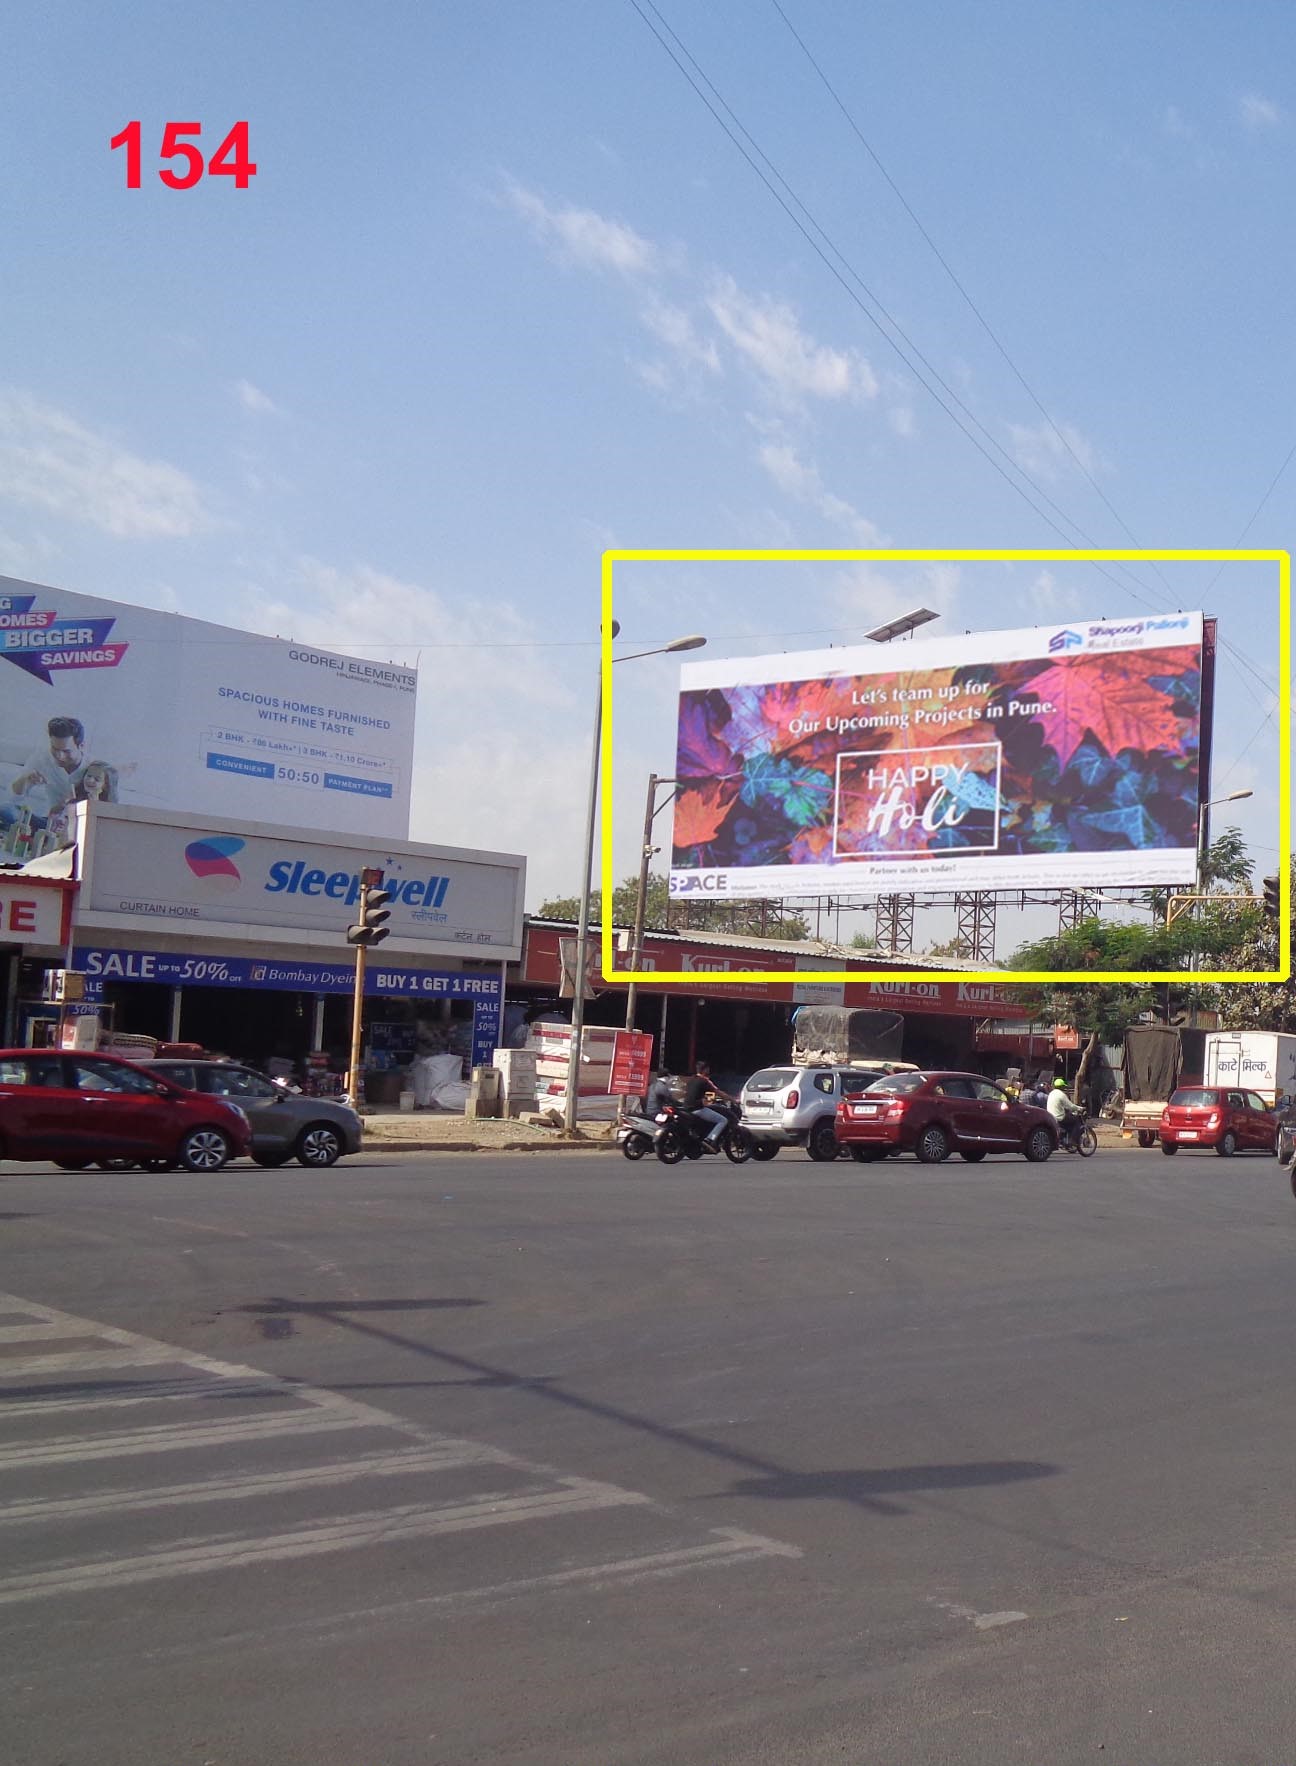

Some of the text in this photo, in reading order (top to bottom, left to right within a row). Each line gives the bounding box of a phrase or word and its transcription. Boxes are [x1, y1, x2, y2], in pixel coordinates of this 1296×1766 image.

[5, 628, 94, 648] BIGGER
[41, 649, 116, 665] SAVINGS
[289, 650, 416, 686] GODREJ ELEMENTS
[892, 686, 932, 702] team
[938, 685, 960, 702] up
[965, 679, 990, 695] for
[218, 687, 391, 730] SPACIOUS HOMES FURNISHED
[789, 700, 1057, 735] Our Upcoming Projects in Pune.
[258, 709, 355, 736] WITH FINE TASTE
[217, 731, 223, 739] 2
[225, 733, 244, 743] BHK
[310, 748, 327, 759] BHK
[216, 759, 267, 774] CONVENIENT
[278, 767, 319, 784] 50:50
[328, 779, 362, 790] PAYMENT
[867, 762, 970, 790] HAPPY
[867, 785, 968, 838] Holi
[900, 866, 918, 874] with
[120, 901, 199, 917] CURTAIN HOME
[86, 953, 156, 978] SALE
[179, 960, 229, 981] 50%
[269, 969, 319, 984] Bombay
[321, 972, 365, 985] Dyein
[377, 974, 405, 989] BUY
[409, 975, 418, 989] 1
[423, 977, 449, 991] GET
[452, 978, 461, 992] 1
[463, 979, 499, 994] FREE
[476, 1002, 499, 1012] SALE
[476, 1022, 496, 1031] 50%
[1218, 1058, 1267, 1072] काटे मिल्क
